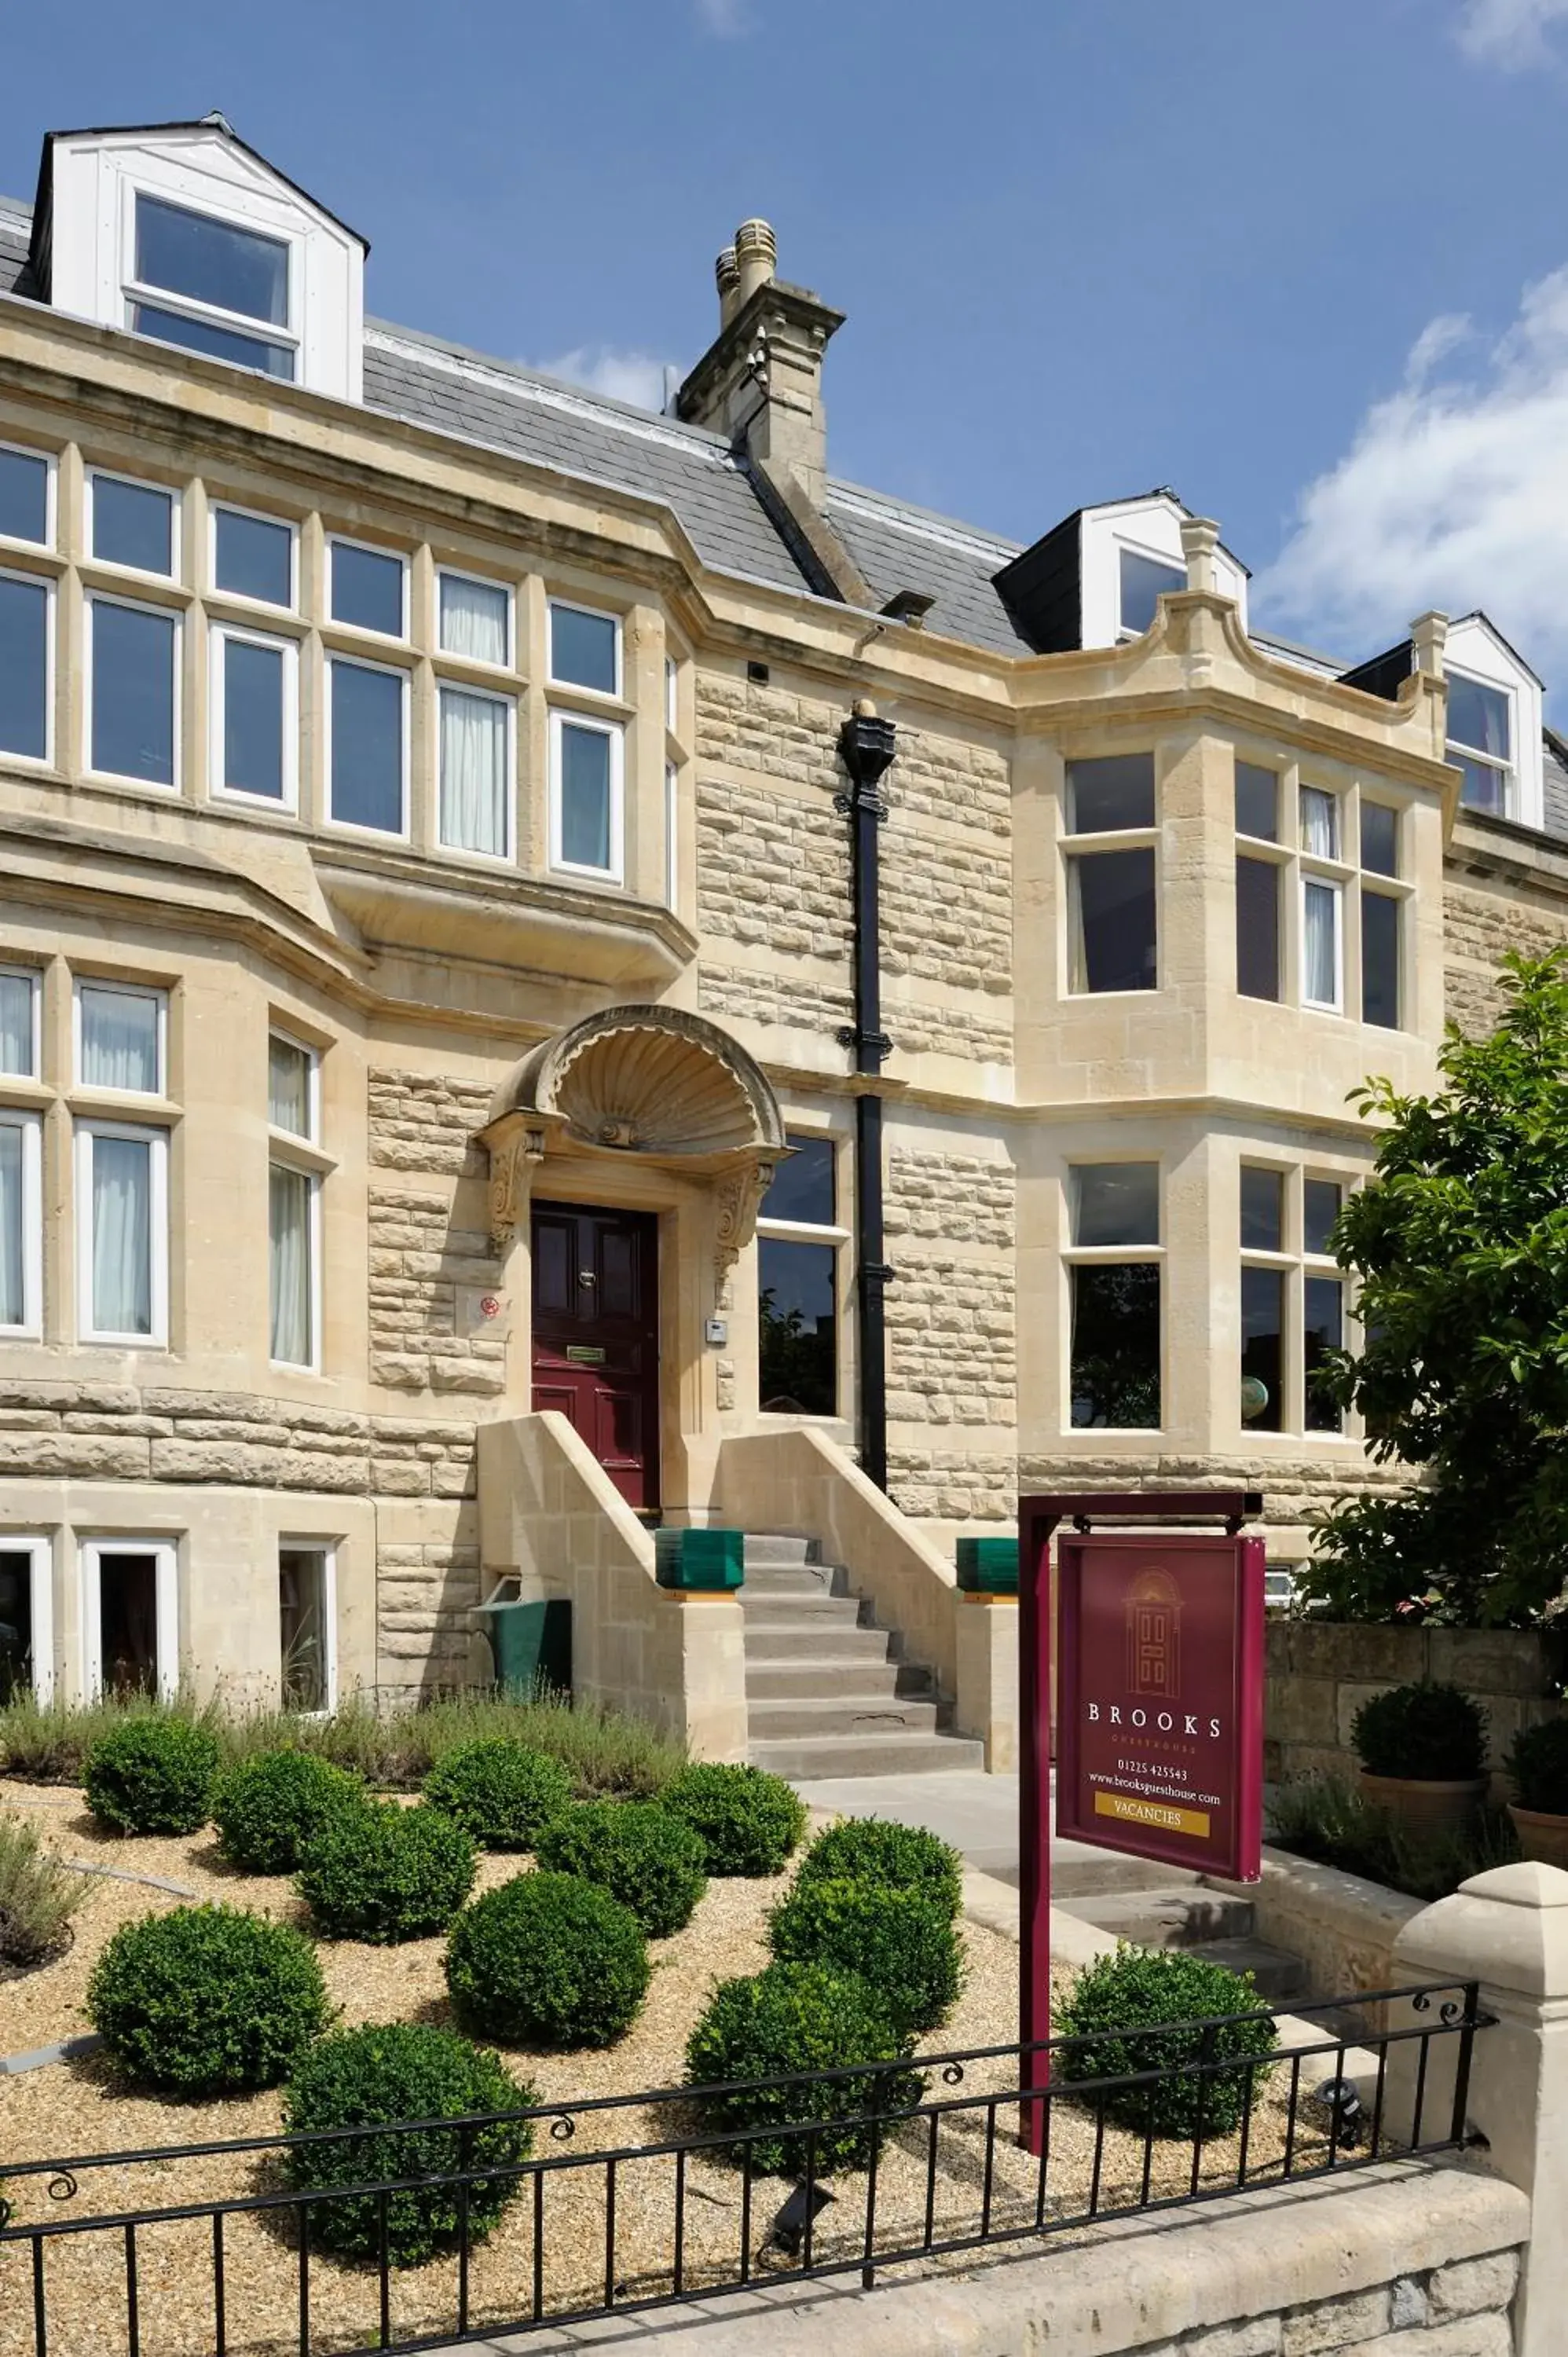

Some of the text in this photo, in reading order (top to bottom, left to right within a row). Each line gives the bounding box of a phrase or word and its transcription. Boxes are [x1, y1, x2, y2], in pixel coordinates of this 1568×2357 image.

[1089, 1703, 1220, 1737] BROOKS
[1118, 1759, 1187, 1781] 01225 425543
[1114, 1800, 1181, 1826] VACANCIES
